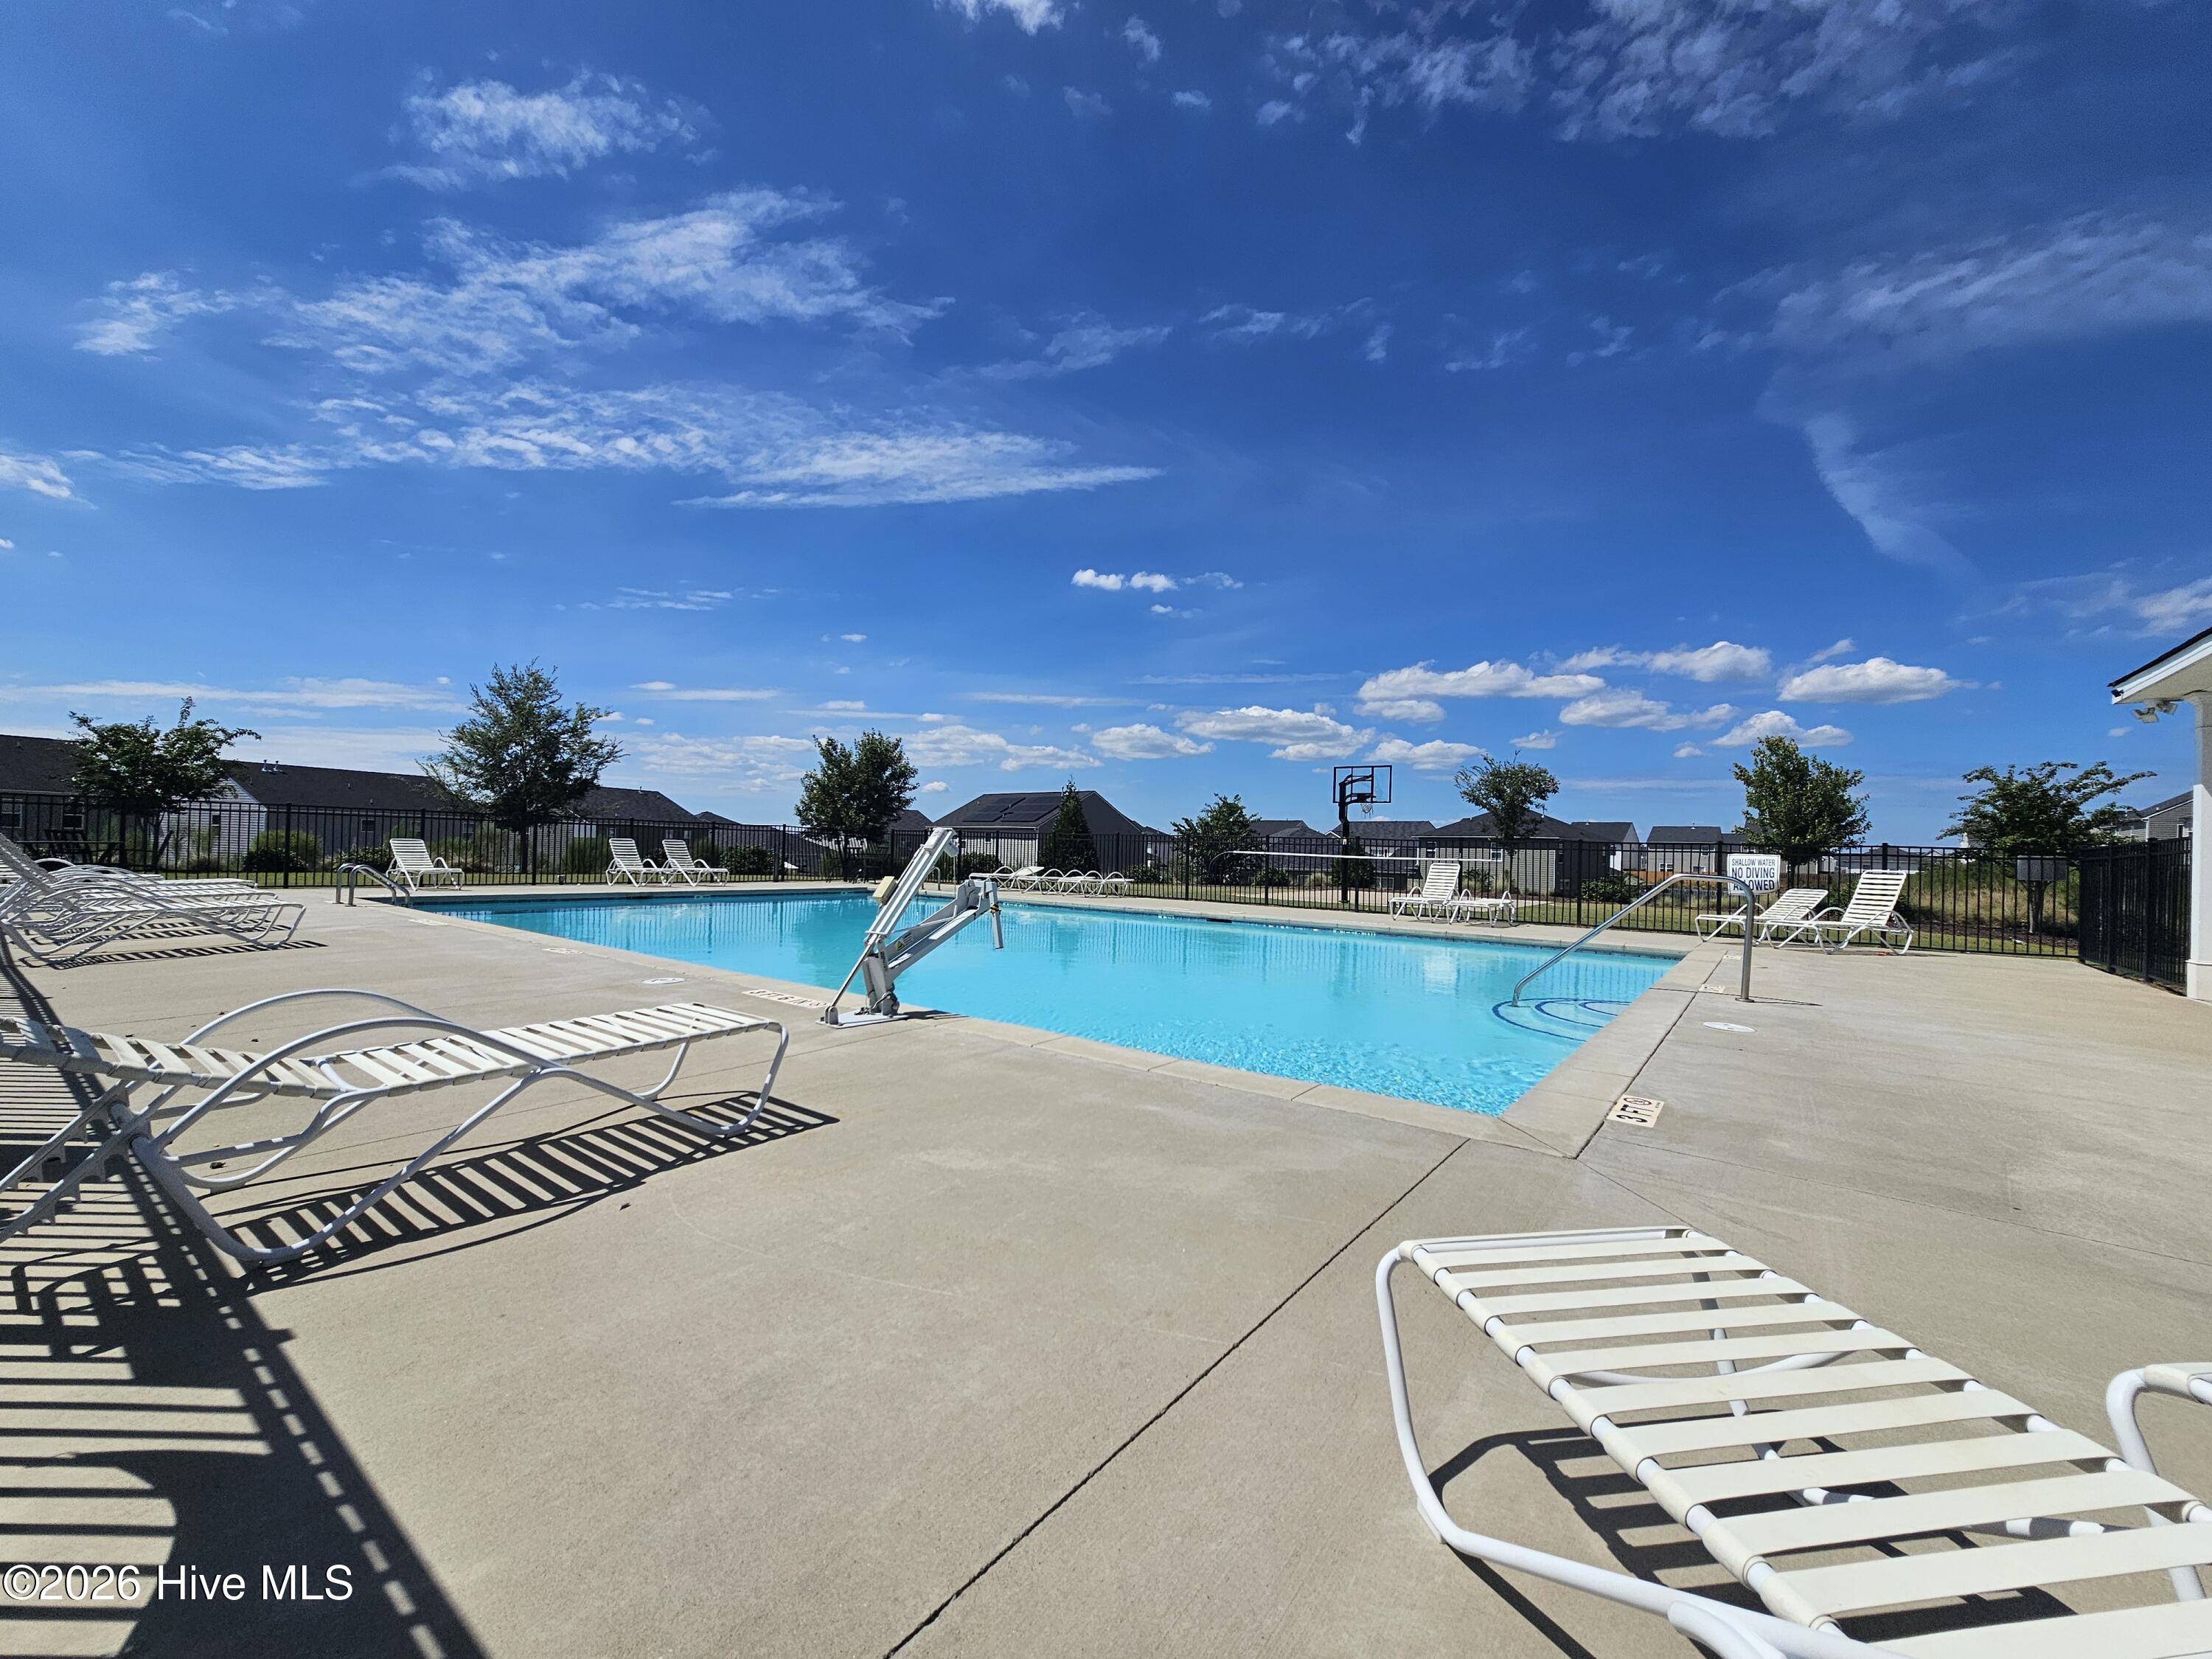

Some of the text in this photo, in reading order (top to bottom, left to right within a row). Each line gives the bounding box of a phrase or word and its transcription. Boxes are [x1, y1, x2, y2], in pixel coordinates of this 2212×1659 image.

[1731, 858, 1775, 866] SHALLOW WATER
[1732, 867, 1775, 878] NO DIVING
[1733, 880, 1775, 891] AOWED
[1616, 1104, 1654, 1122] 3 FT
